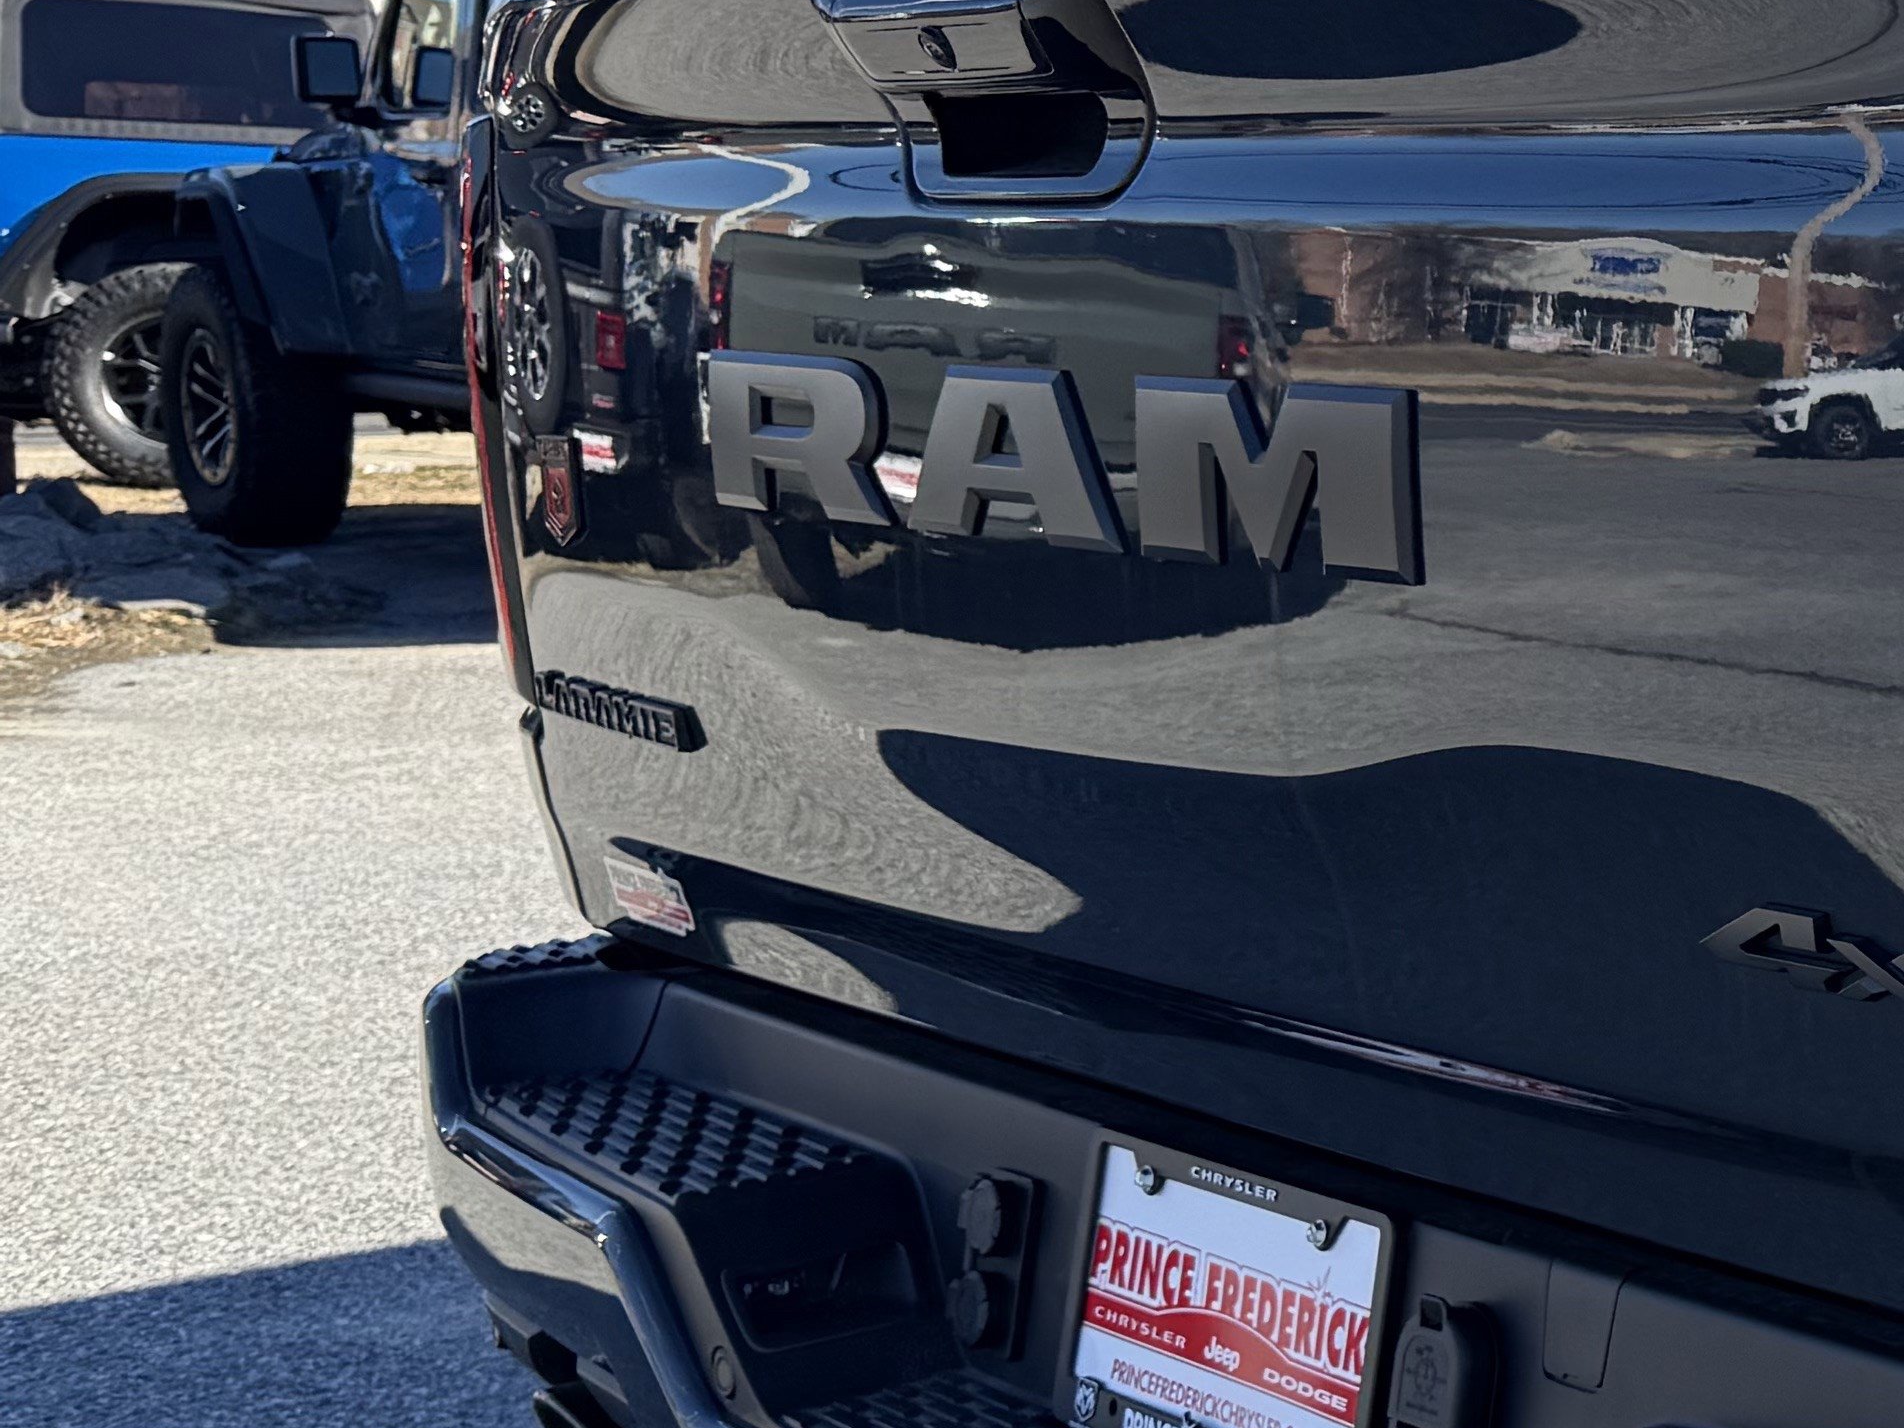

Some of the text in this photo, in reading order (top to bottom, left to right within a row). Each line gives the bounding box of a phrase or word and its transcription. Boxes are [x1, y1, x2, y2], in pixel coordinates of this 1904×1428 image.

[706, 347, 1426, 585] RAM
[1190, 1165, 1278, 1203] CHRYSLER
[1088, 1222, 1371, 1376] PRINCE FREDERICK
[1093, 1305, 1349, 1413] CHRYSLER Jeep DODGE
